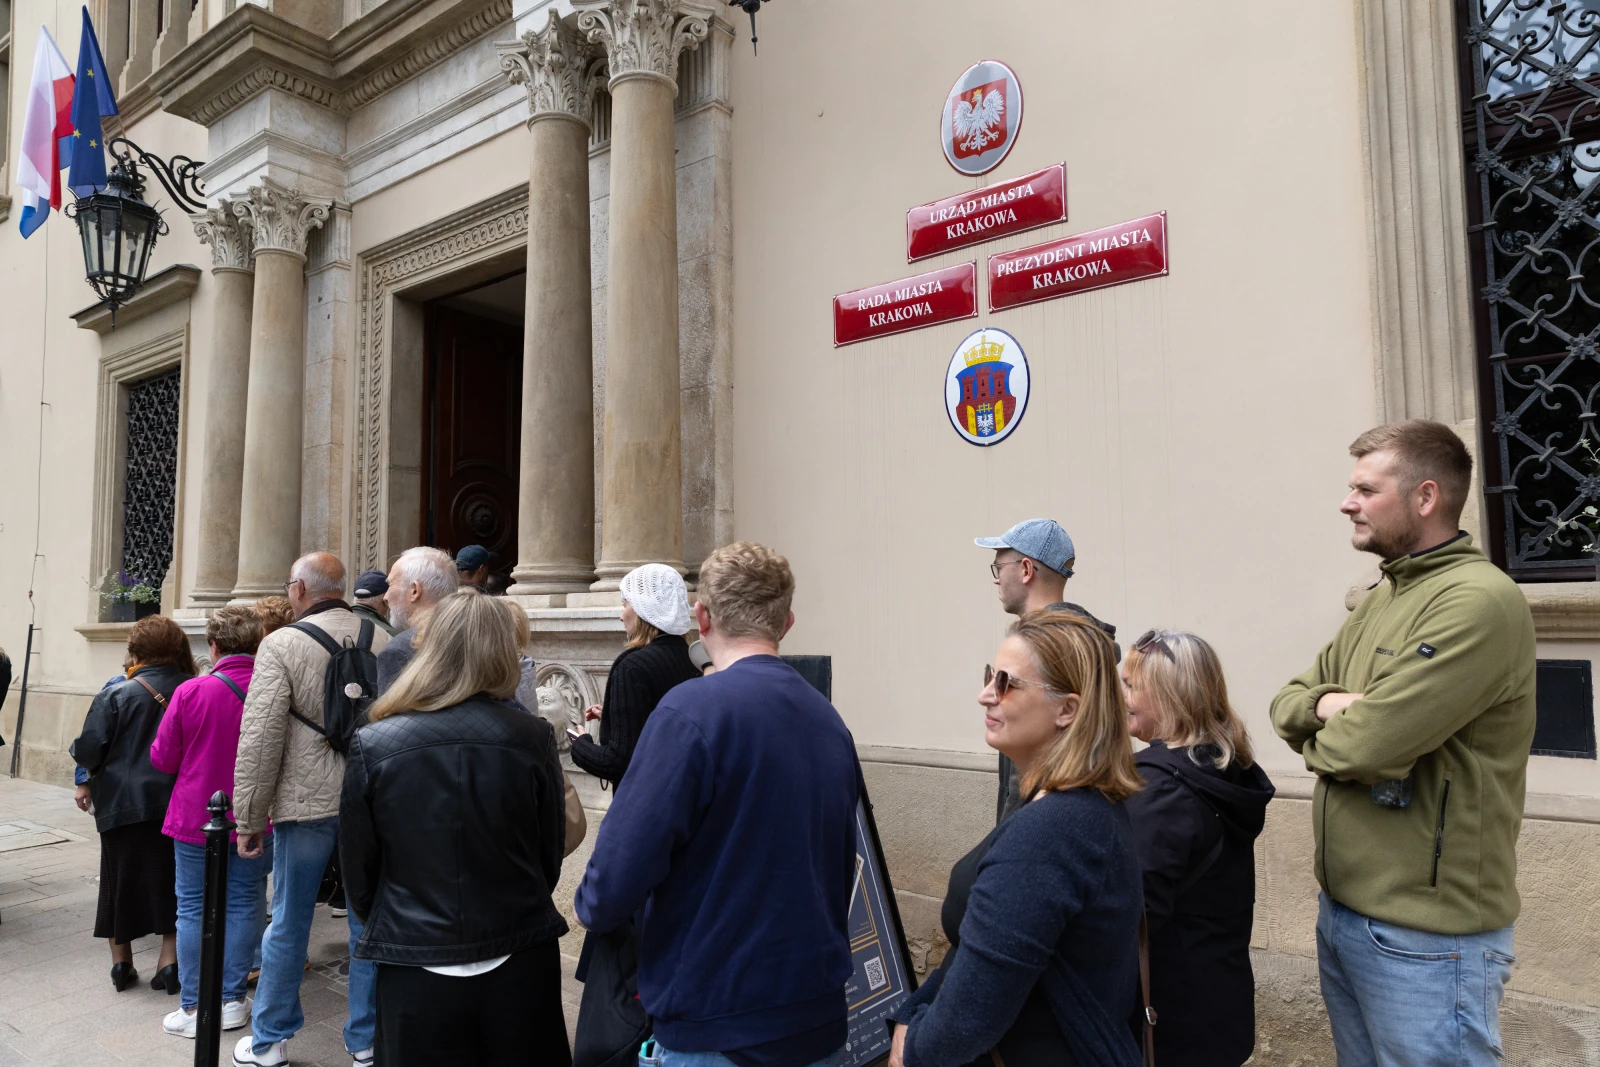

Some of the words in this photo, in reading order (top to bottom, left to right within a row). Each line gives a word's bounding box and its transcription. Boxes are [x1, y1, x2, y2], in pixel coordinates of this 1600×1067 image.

[929, 200, 977, 224] URZĄD
[980, 183, 1034, 210] MIASTA
[946, 208, 1017, 240] KRAKOWA
[996, 243, 1086, 278] PREZYDENT
[1089, 228, 1152, 255] MIASTA
[1032, 259, 1112, 290] KRAKOWA
[857, 293, 892, 312] RADA
[894, 279, 943, 303] MIASTA
[868, 301, 933, 328] KRAKOWA
